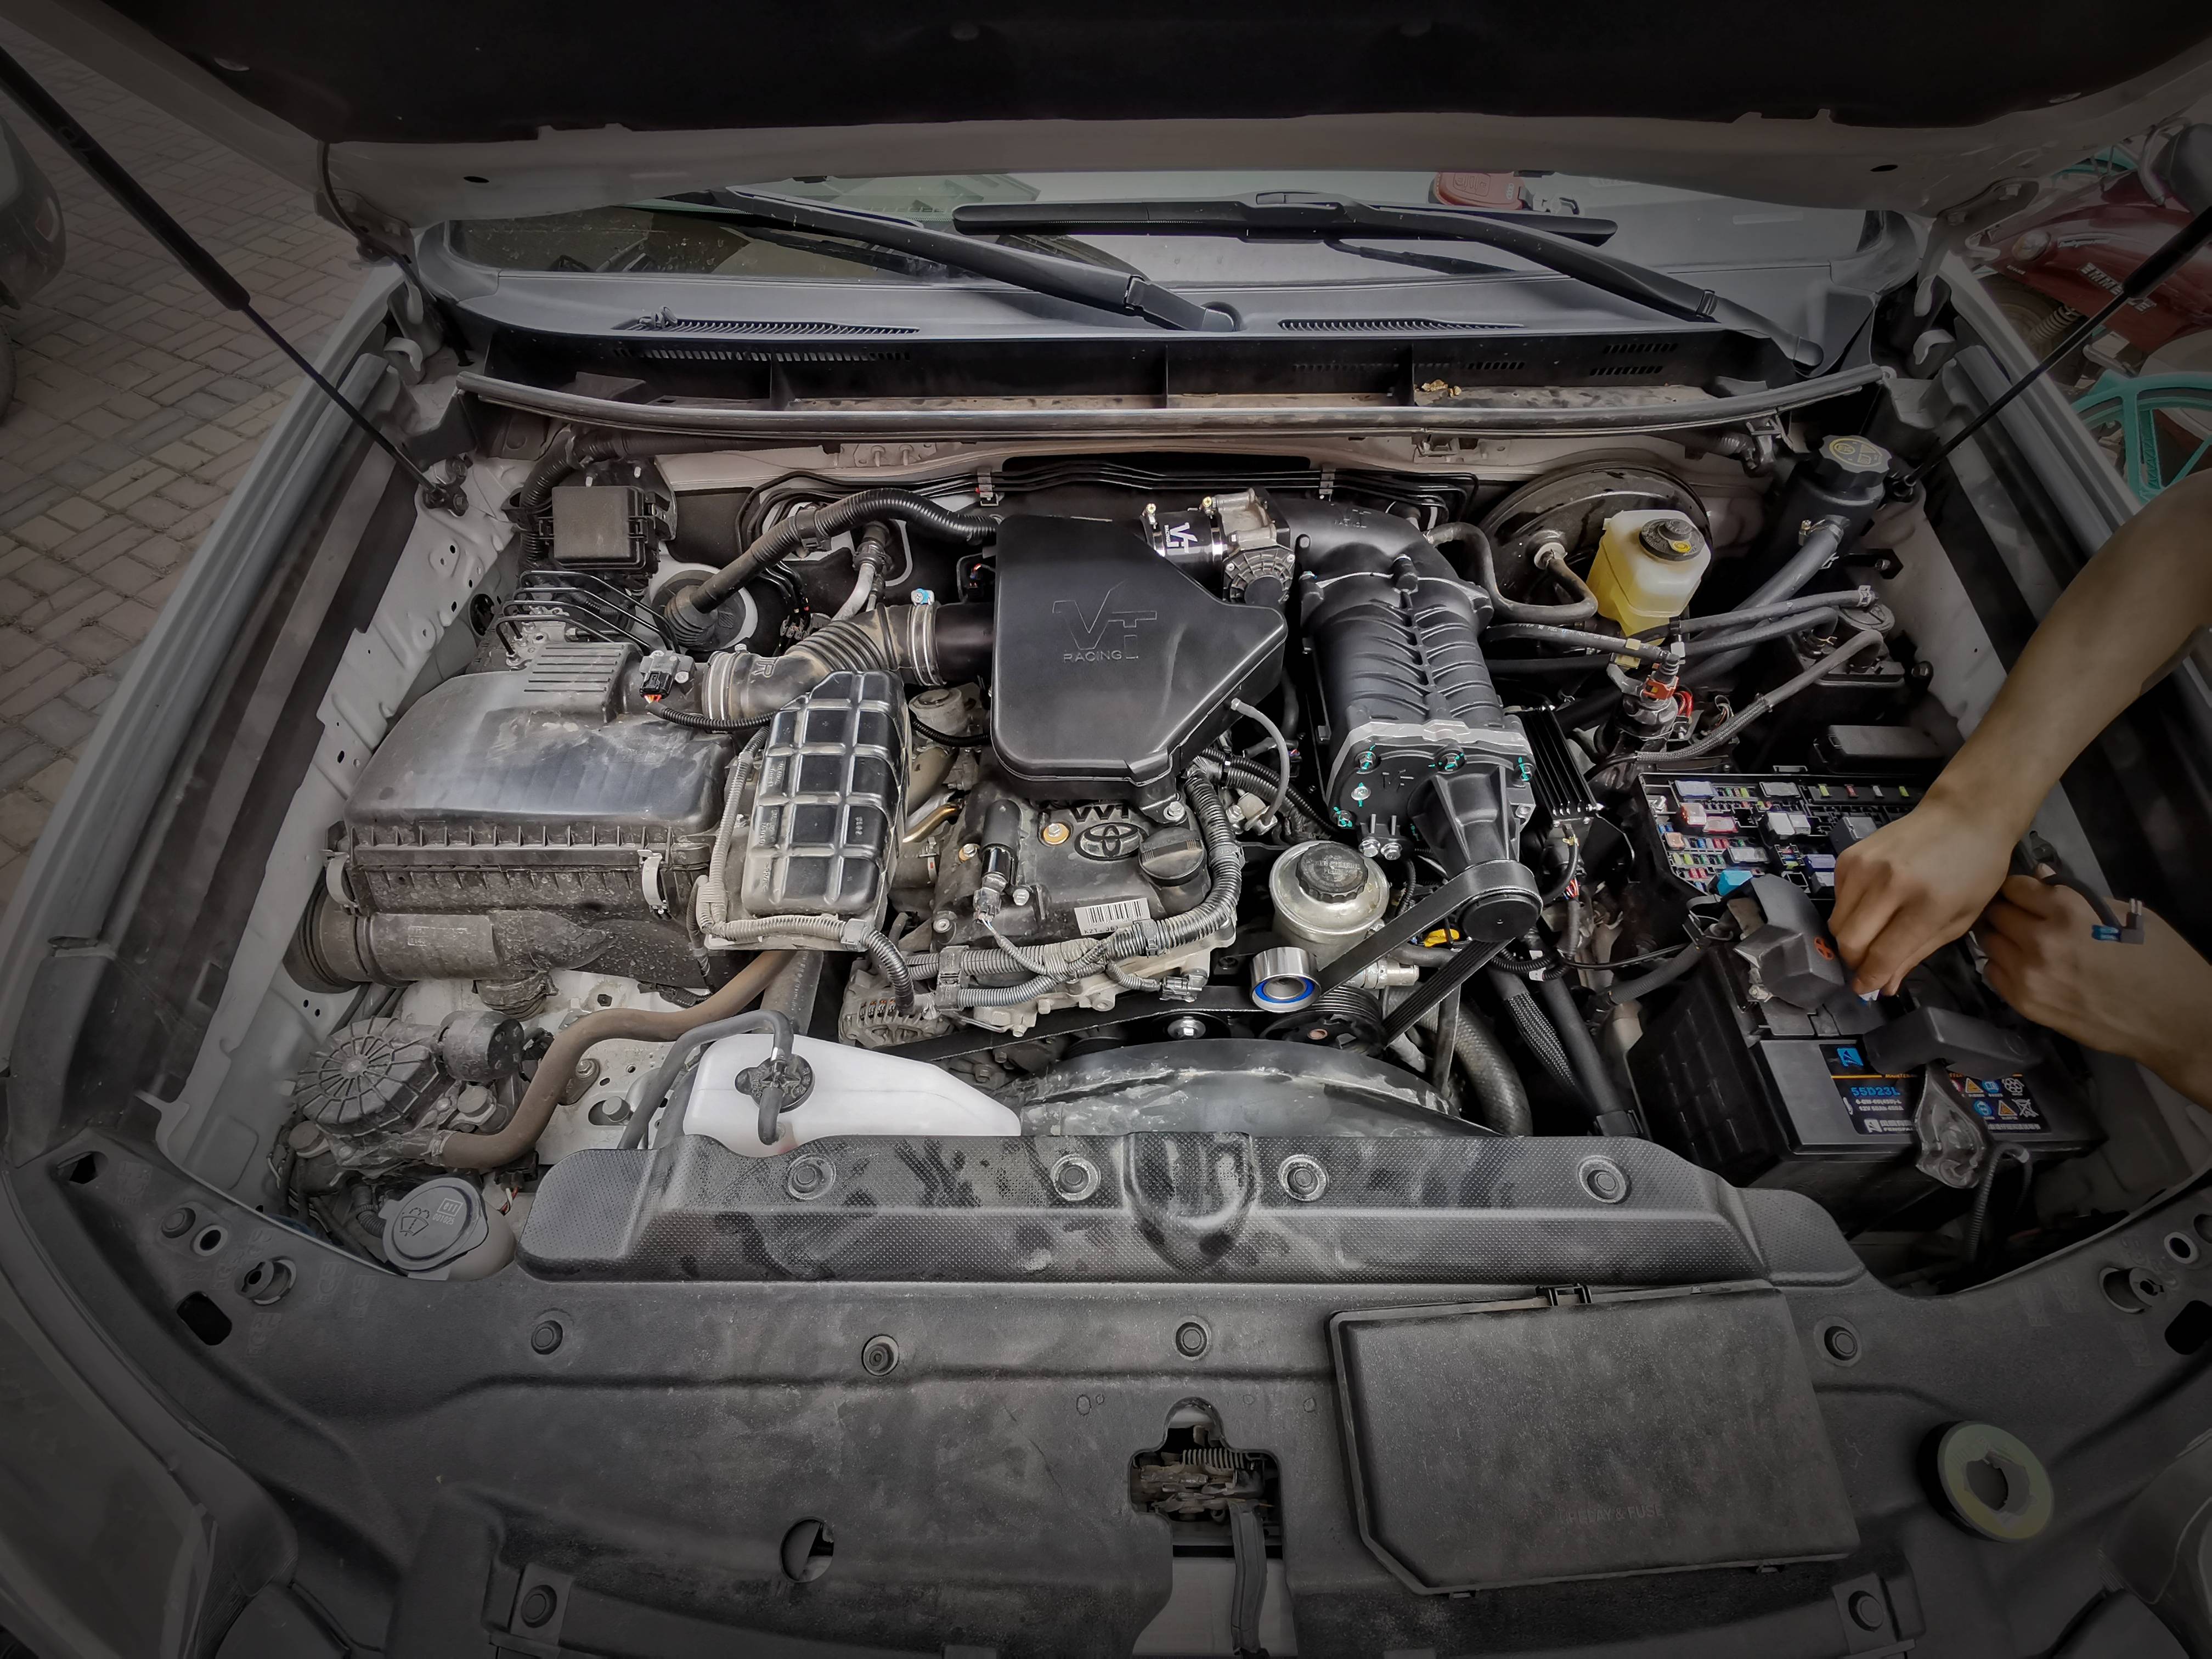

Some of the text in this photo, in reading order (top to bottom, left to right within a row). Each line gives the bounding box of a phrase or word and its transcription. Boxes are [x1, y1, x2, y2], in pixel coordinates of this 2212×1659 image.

[2080, 262, 2153, 312] EMMELE
[1063, 650, 1122, 663] RACING
[1850, 1086, 1901, 1097] 55D23L
